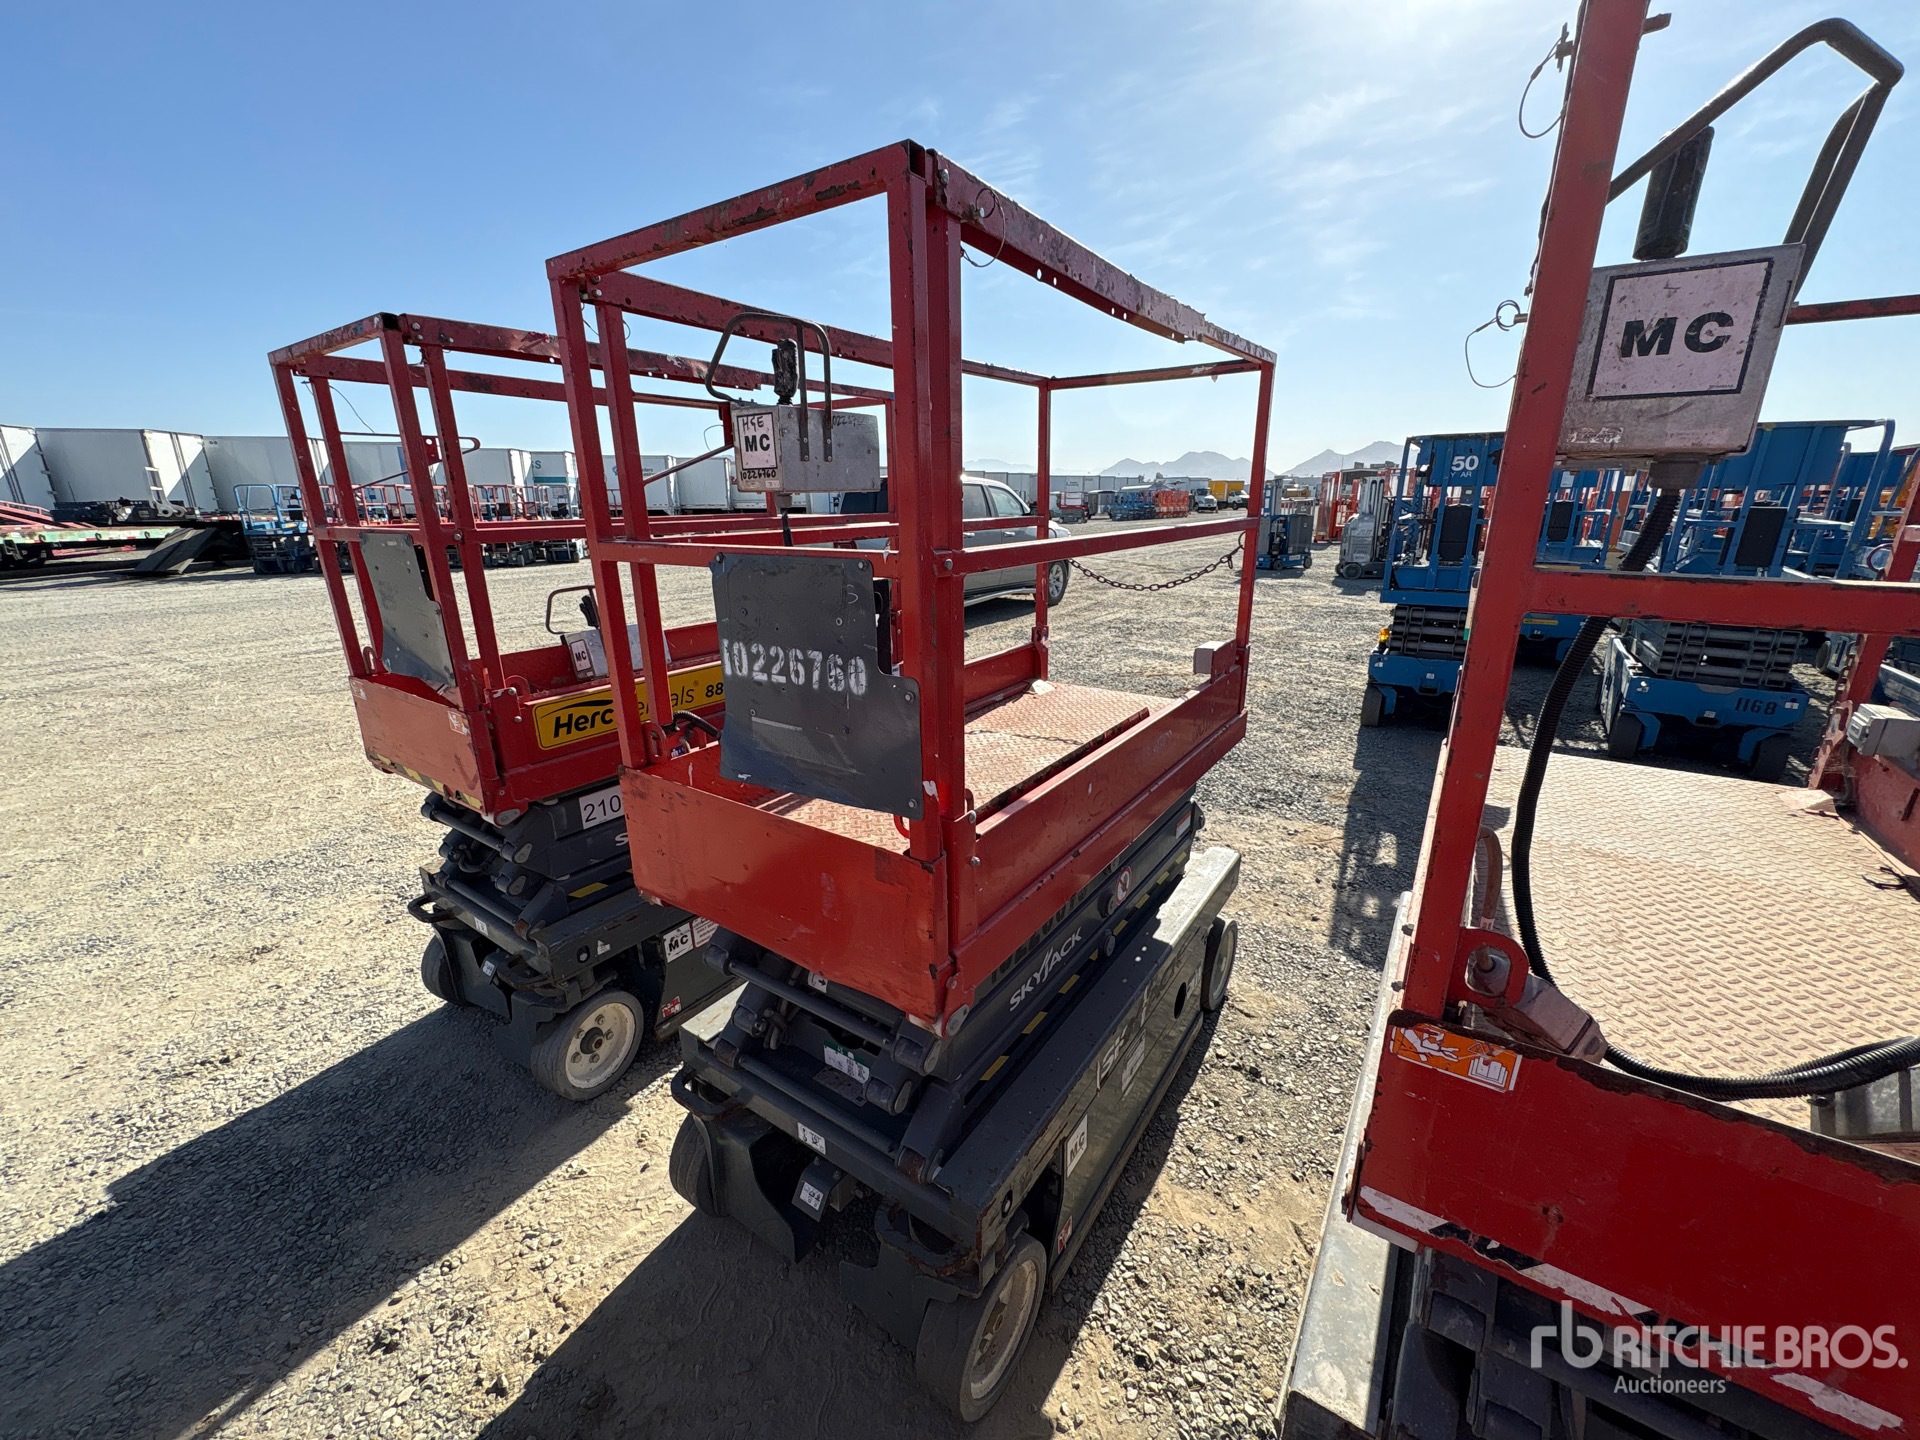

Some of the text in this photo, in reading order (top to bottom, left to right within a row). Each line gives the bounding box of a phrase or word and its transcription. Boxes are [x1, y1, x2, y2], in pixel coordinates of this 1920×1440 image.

[1620, 312, 1734, 358] MC
[744, 433, 770, 452] MC
[1451, 455, 1479, 472] 50
[575, 650, 587, 662] MC
[722, 638, 867, 696] 10226760
[1734, 697, 1778, 716] 1168
[553, 707, 615, 738] Herc
[668, 934, 690, 953] MC
[1009, 927, 1083, 1012] SKYJACK
